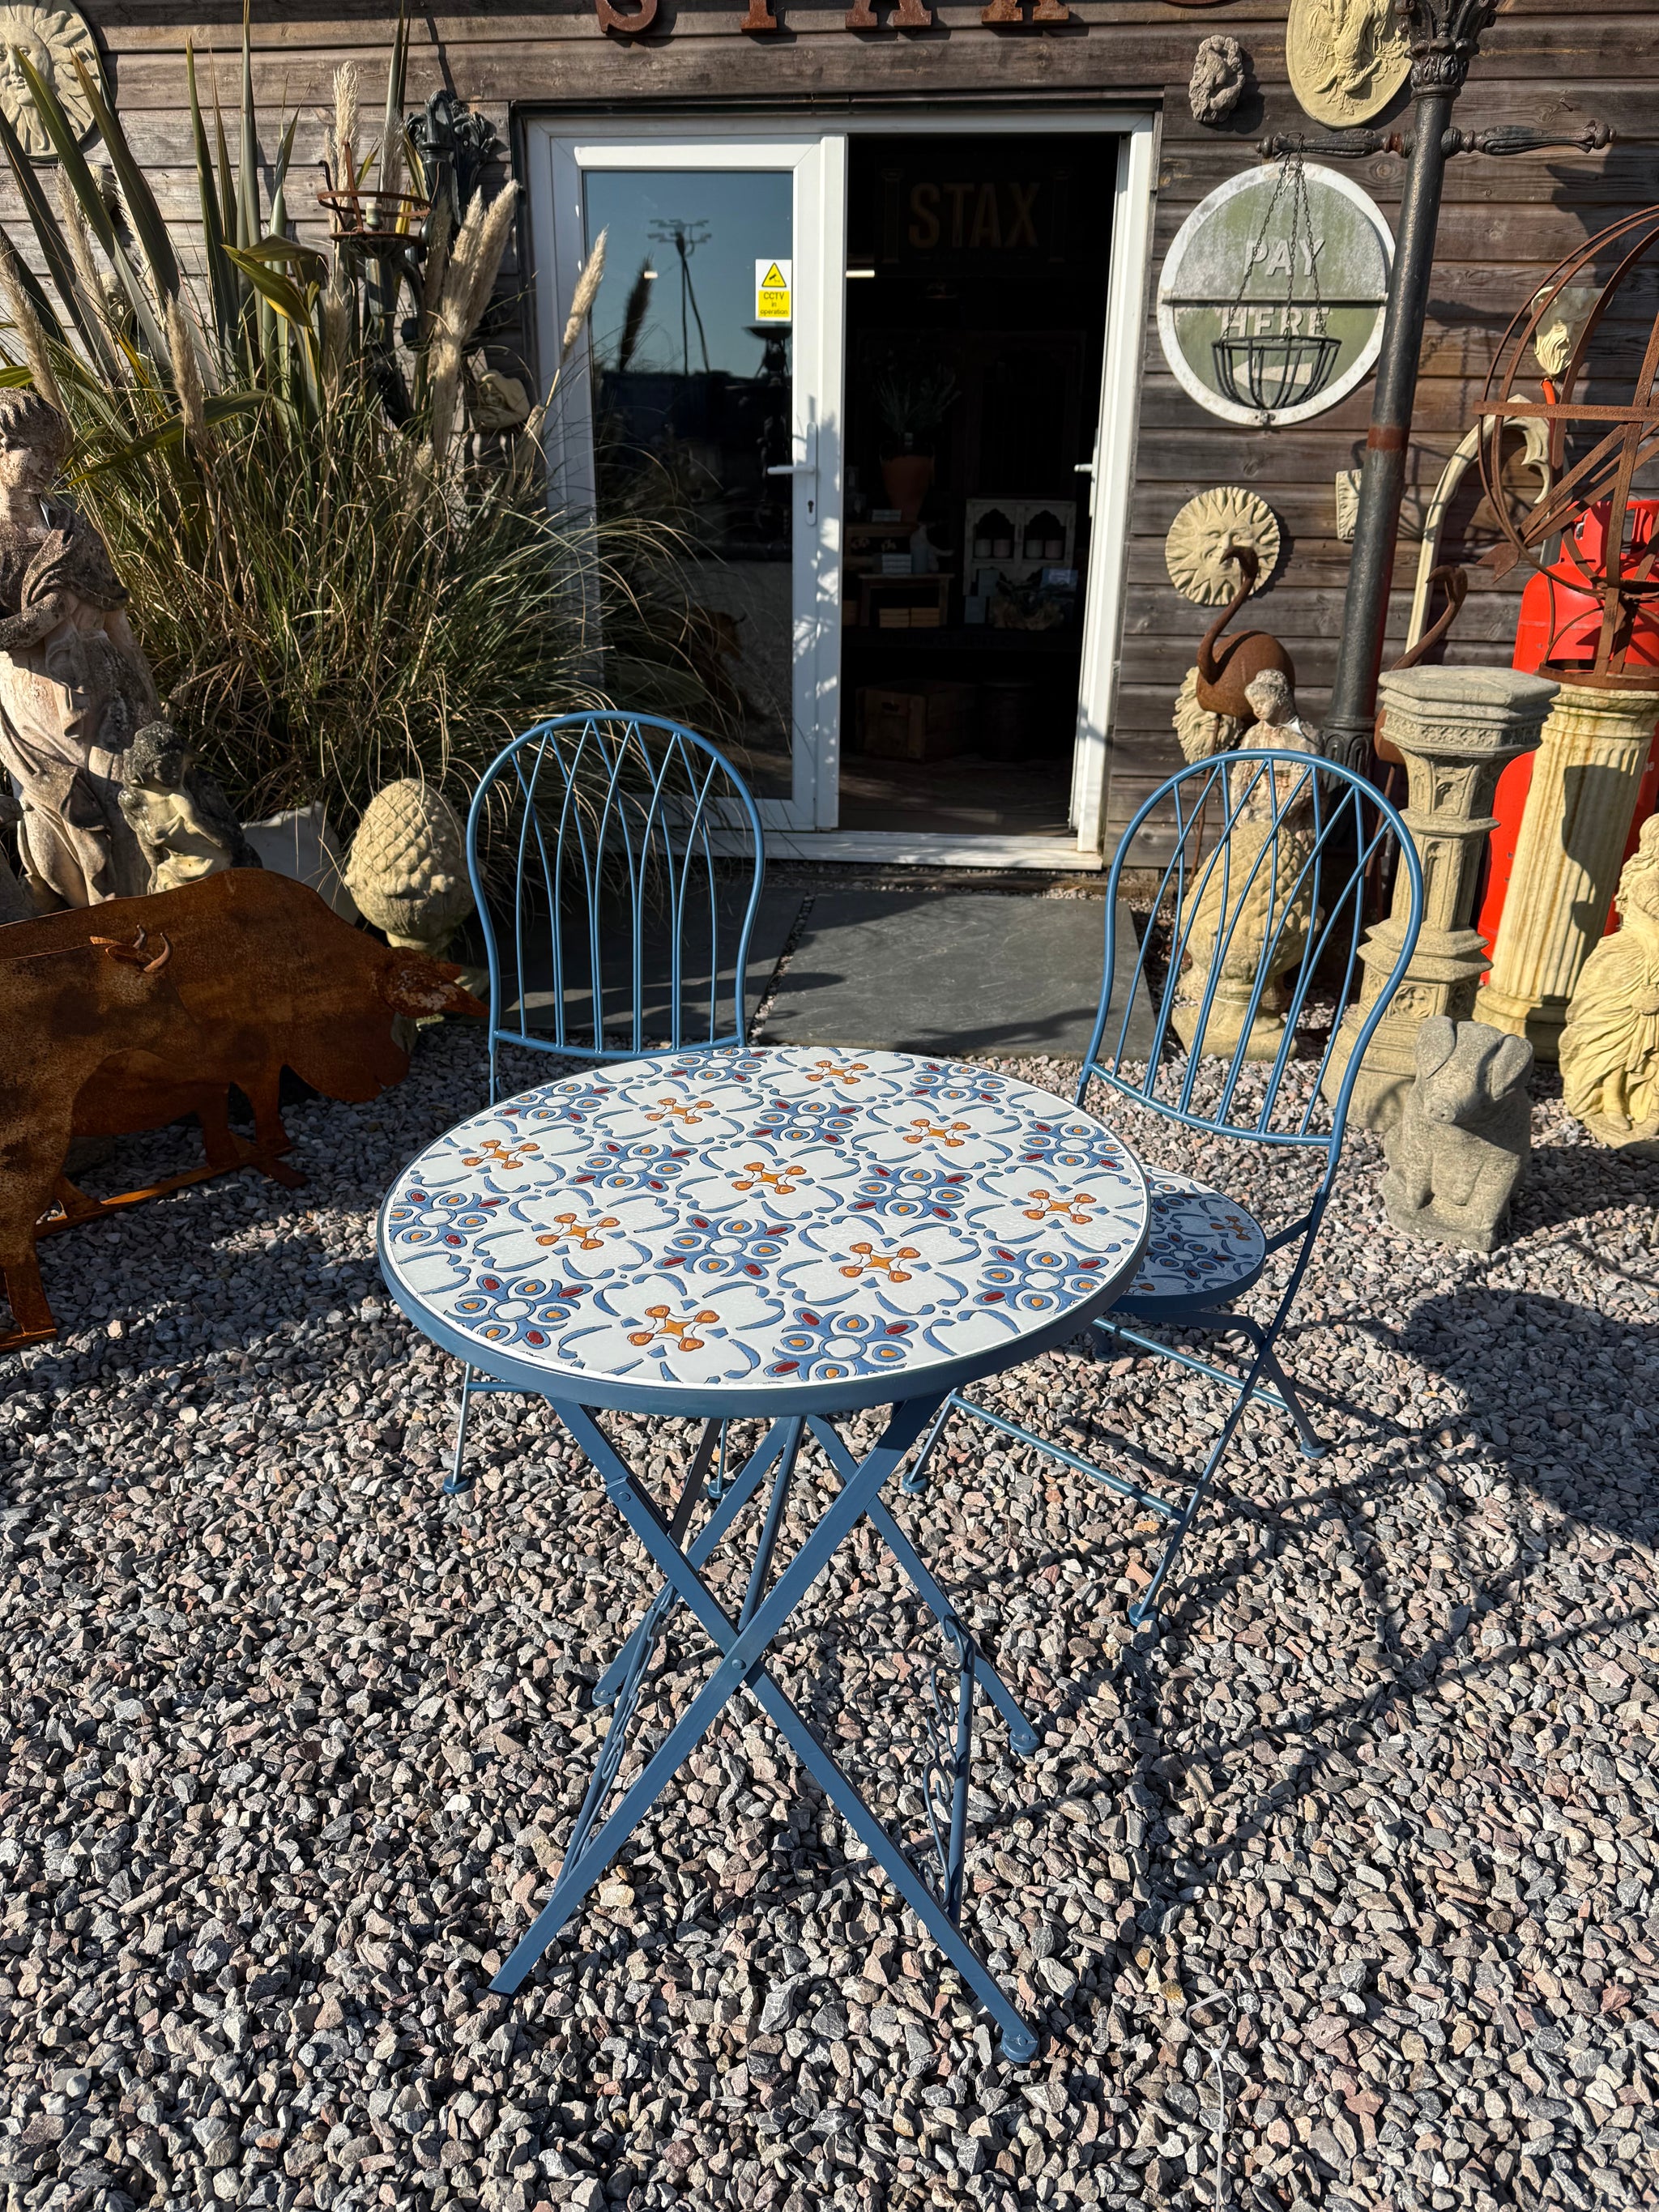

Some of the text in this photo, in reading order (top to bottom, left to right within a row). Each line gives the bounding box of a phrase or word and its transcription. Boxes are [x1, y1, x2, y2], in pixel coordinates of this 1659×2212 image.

[909, 182, 1040, 249] STAX
[1243, 240, 1325, 276] PAY
[763, 292, 785, 300] CCTV
[1221, 306, 1330, 342] HERE
